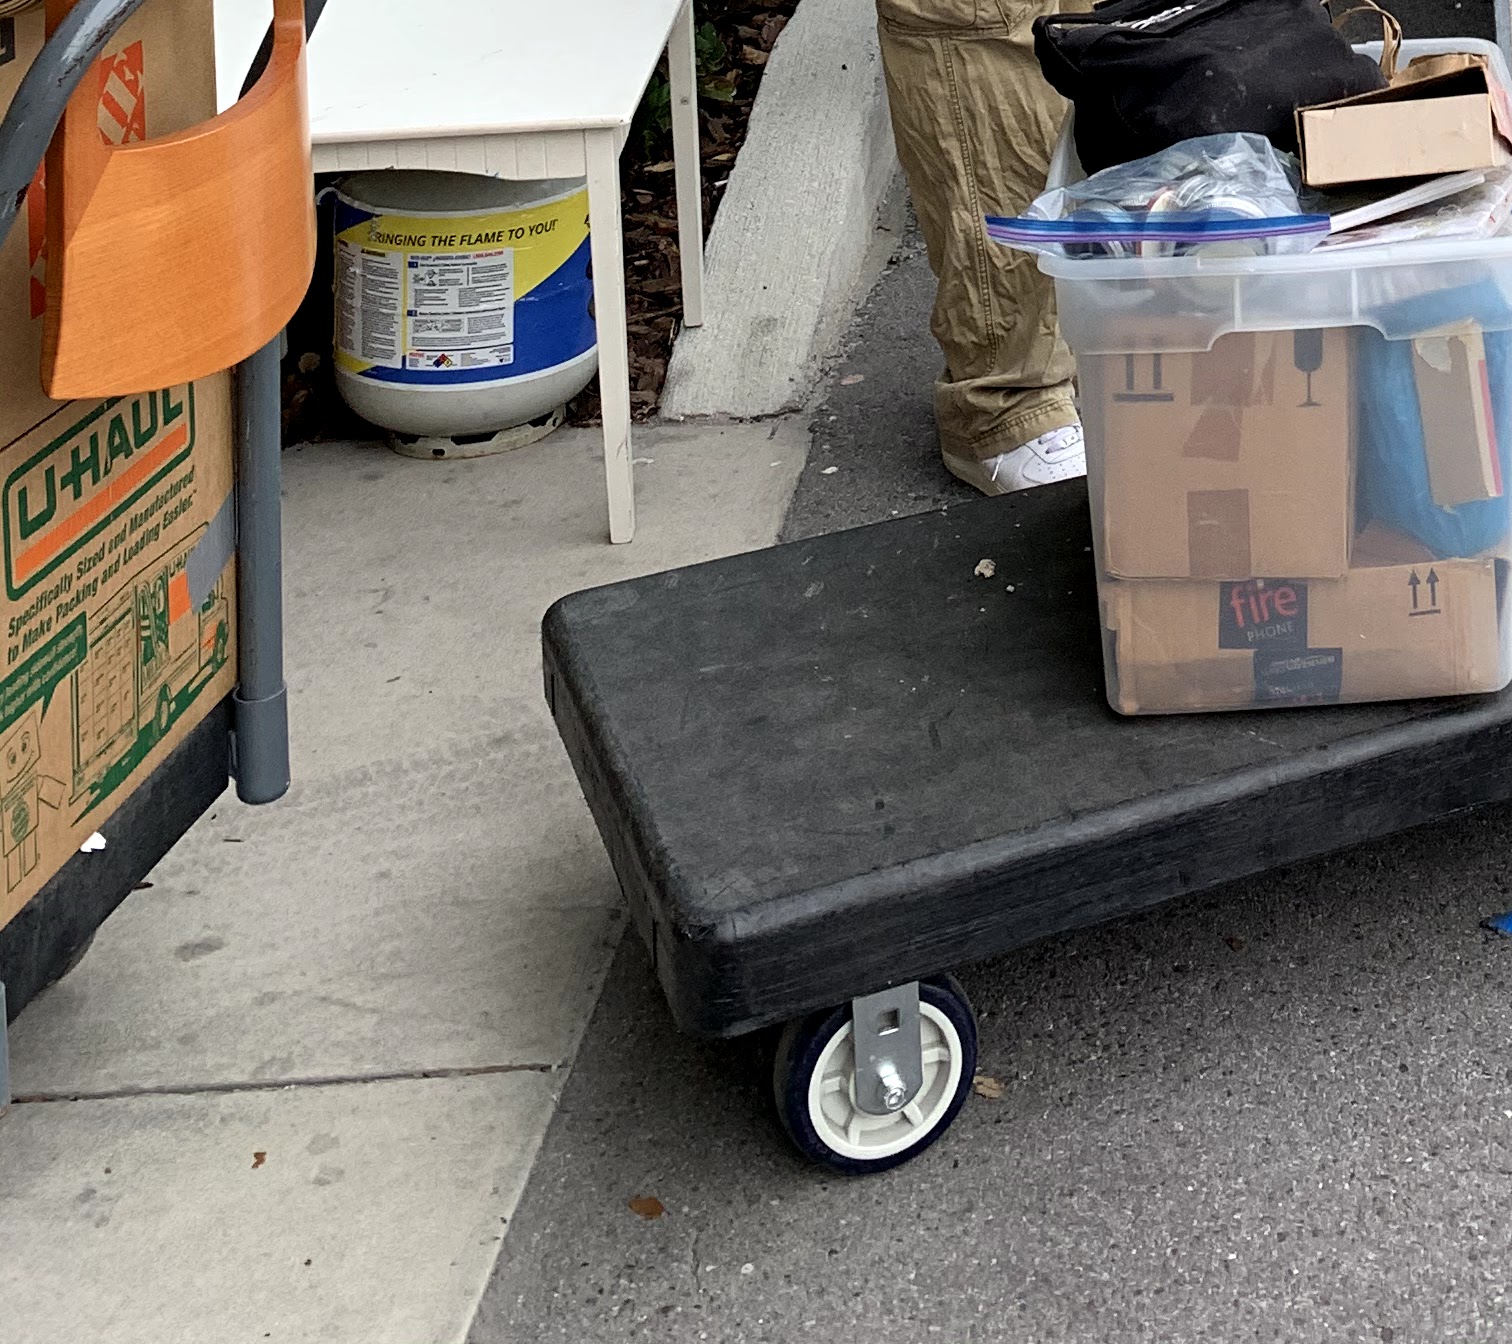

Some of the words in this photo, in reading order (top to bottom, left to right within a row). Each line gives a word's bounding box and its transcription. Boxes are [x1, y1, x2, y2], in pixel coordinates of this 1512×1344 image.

[368, 230, 427, 247] RINGING
[431, 234, 457, 247] THE
[459, 230, 505, 247] FLAME
[507, 226, 525, 241] TO
[528, 218, 559, 238] YOU!
[17, 387, 184, 541] U-HAUL
[8, 574, 74, 640] Specifically
[76, 543, 105, 579] Sized
[108, 523, 127, 555] and
[129, 464, 196, 538] Manufactured
[8, 645, 19, 666] to
[22, 615, 52, 656] Make
[56, 574, 99, 626] Packing
[101, 557, 121, 586] and
[123, 521, 161, 569] Loading
[1230, 579, 1299, 629] fire
[1247, 621, 1294, 642] PHONE
